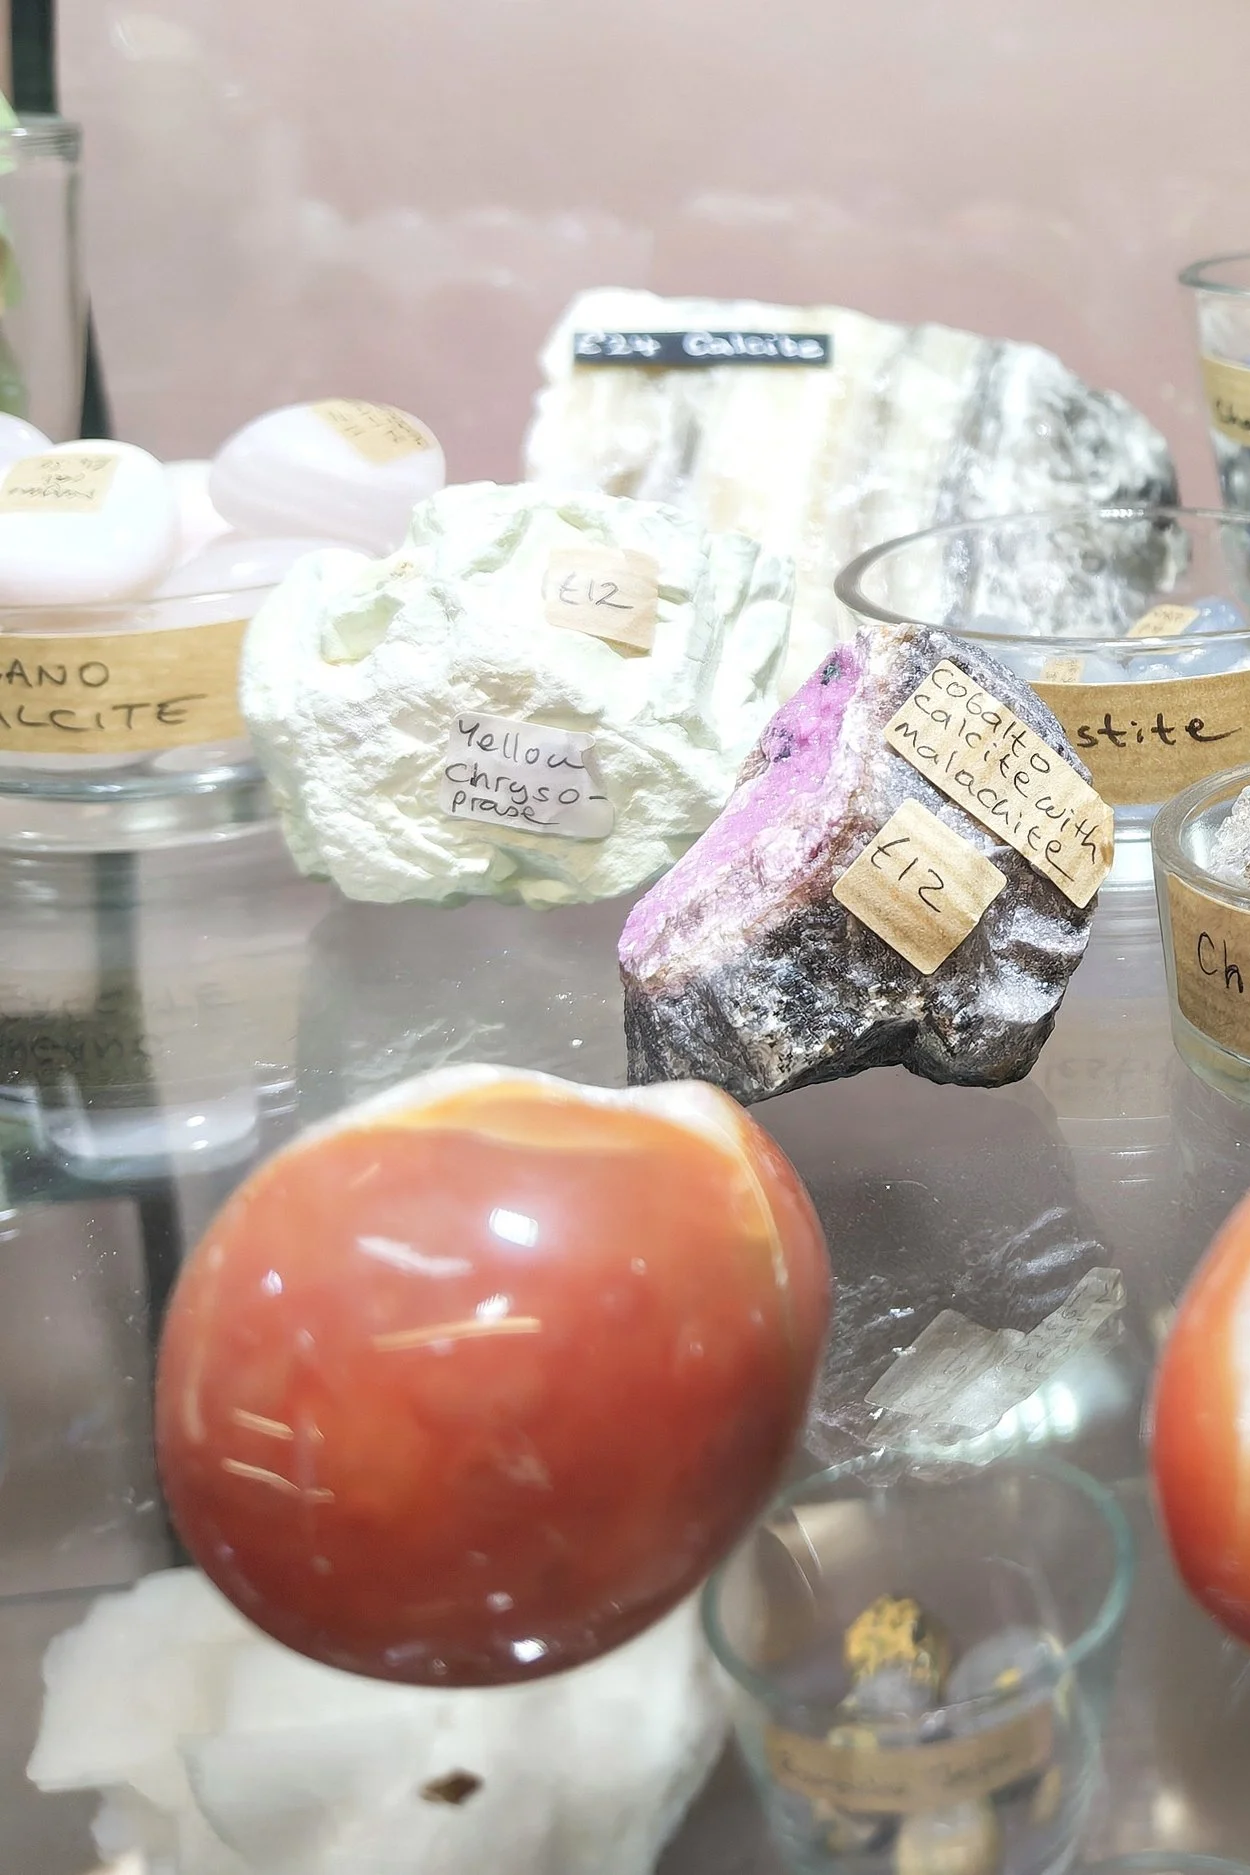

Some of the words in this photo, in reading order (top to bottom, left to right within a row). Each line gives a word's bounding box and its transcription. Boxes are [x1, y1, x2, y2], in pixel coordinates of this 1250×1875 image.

[0, 659, 110, 689] ANO
[1076, 713, 1243, 749] stite
[1035, 794, 1099, 865] with
